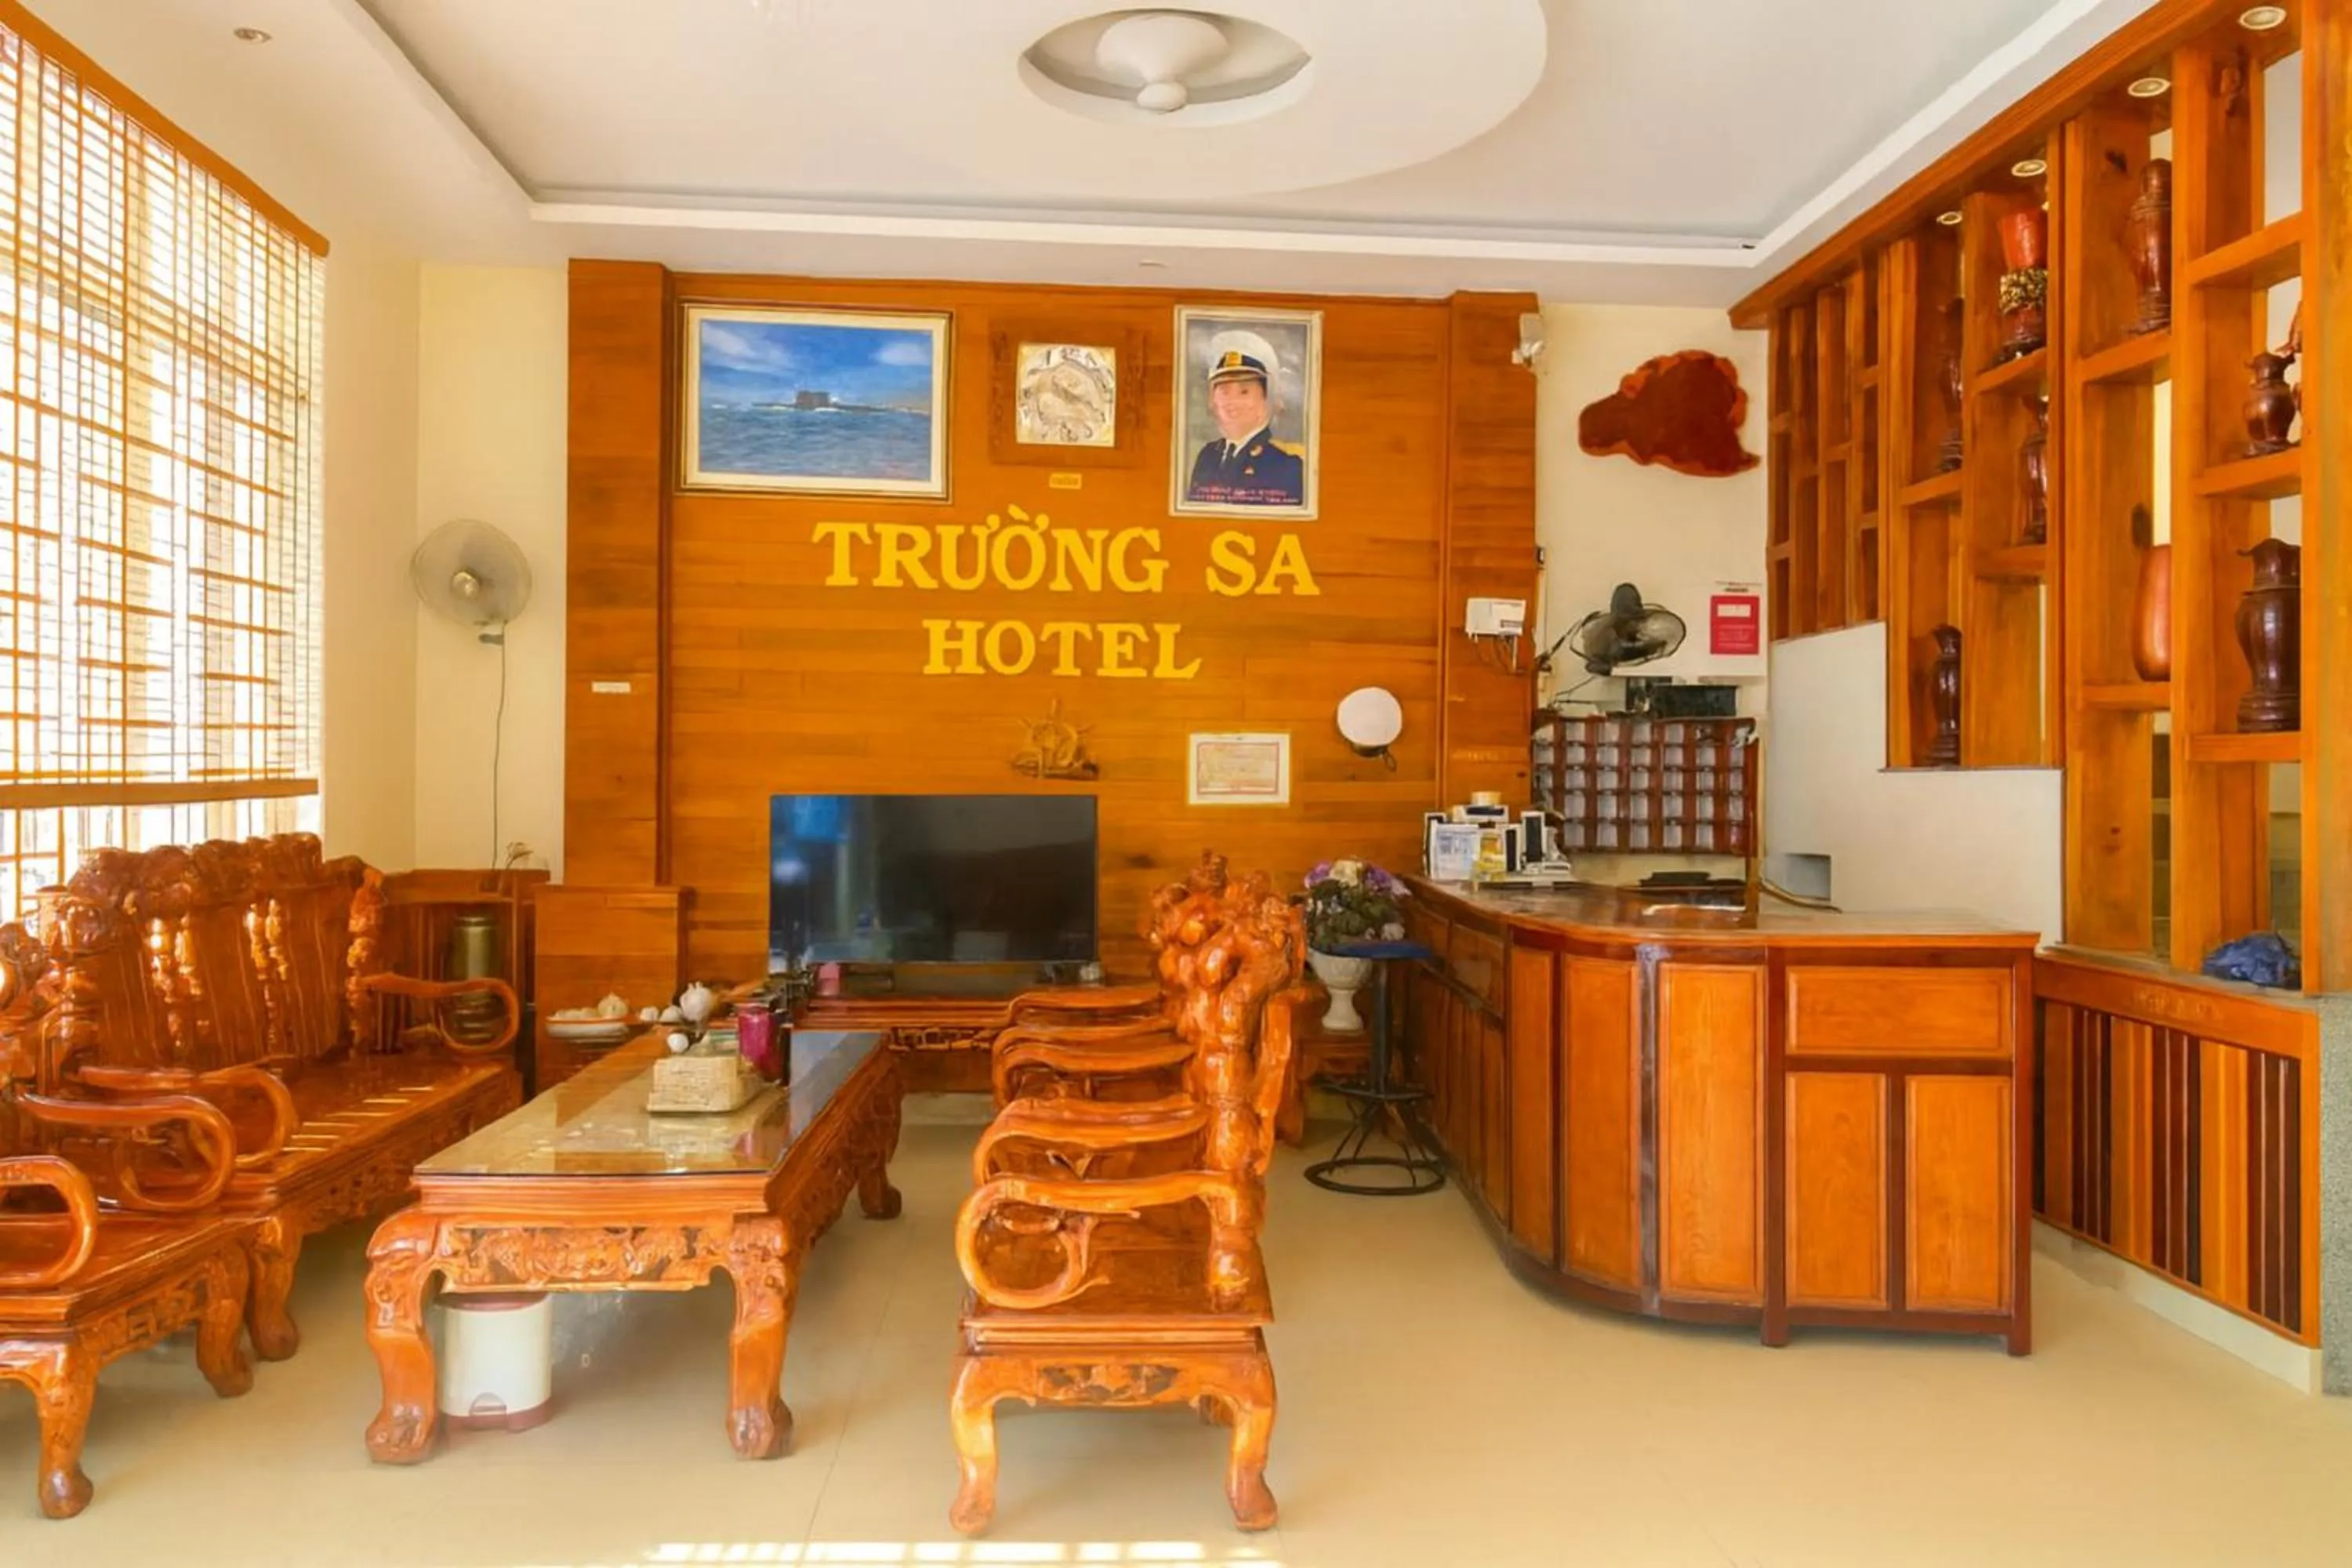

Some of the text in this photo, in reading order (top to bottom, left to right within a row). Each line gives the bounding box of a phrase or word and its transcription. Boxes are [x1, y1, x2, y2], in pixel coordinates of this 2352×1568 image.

[812, 504, 1320, 597] TRƯỜNG SA
[922, 619, 1202, 679] HOTEL
